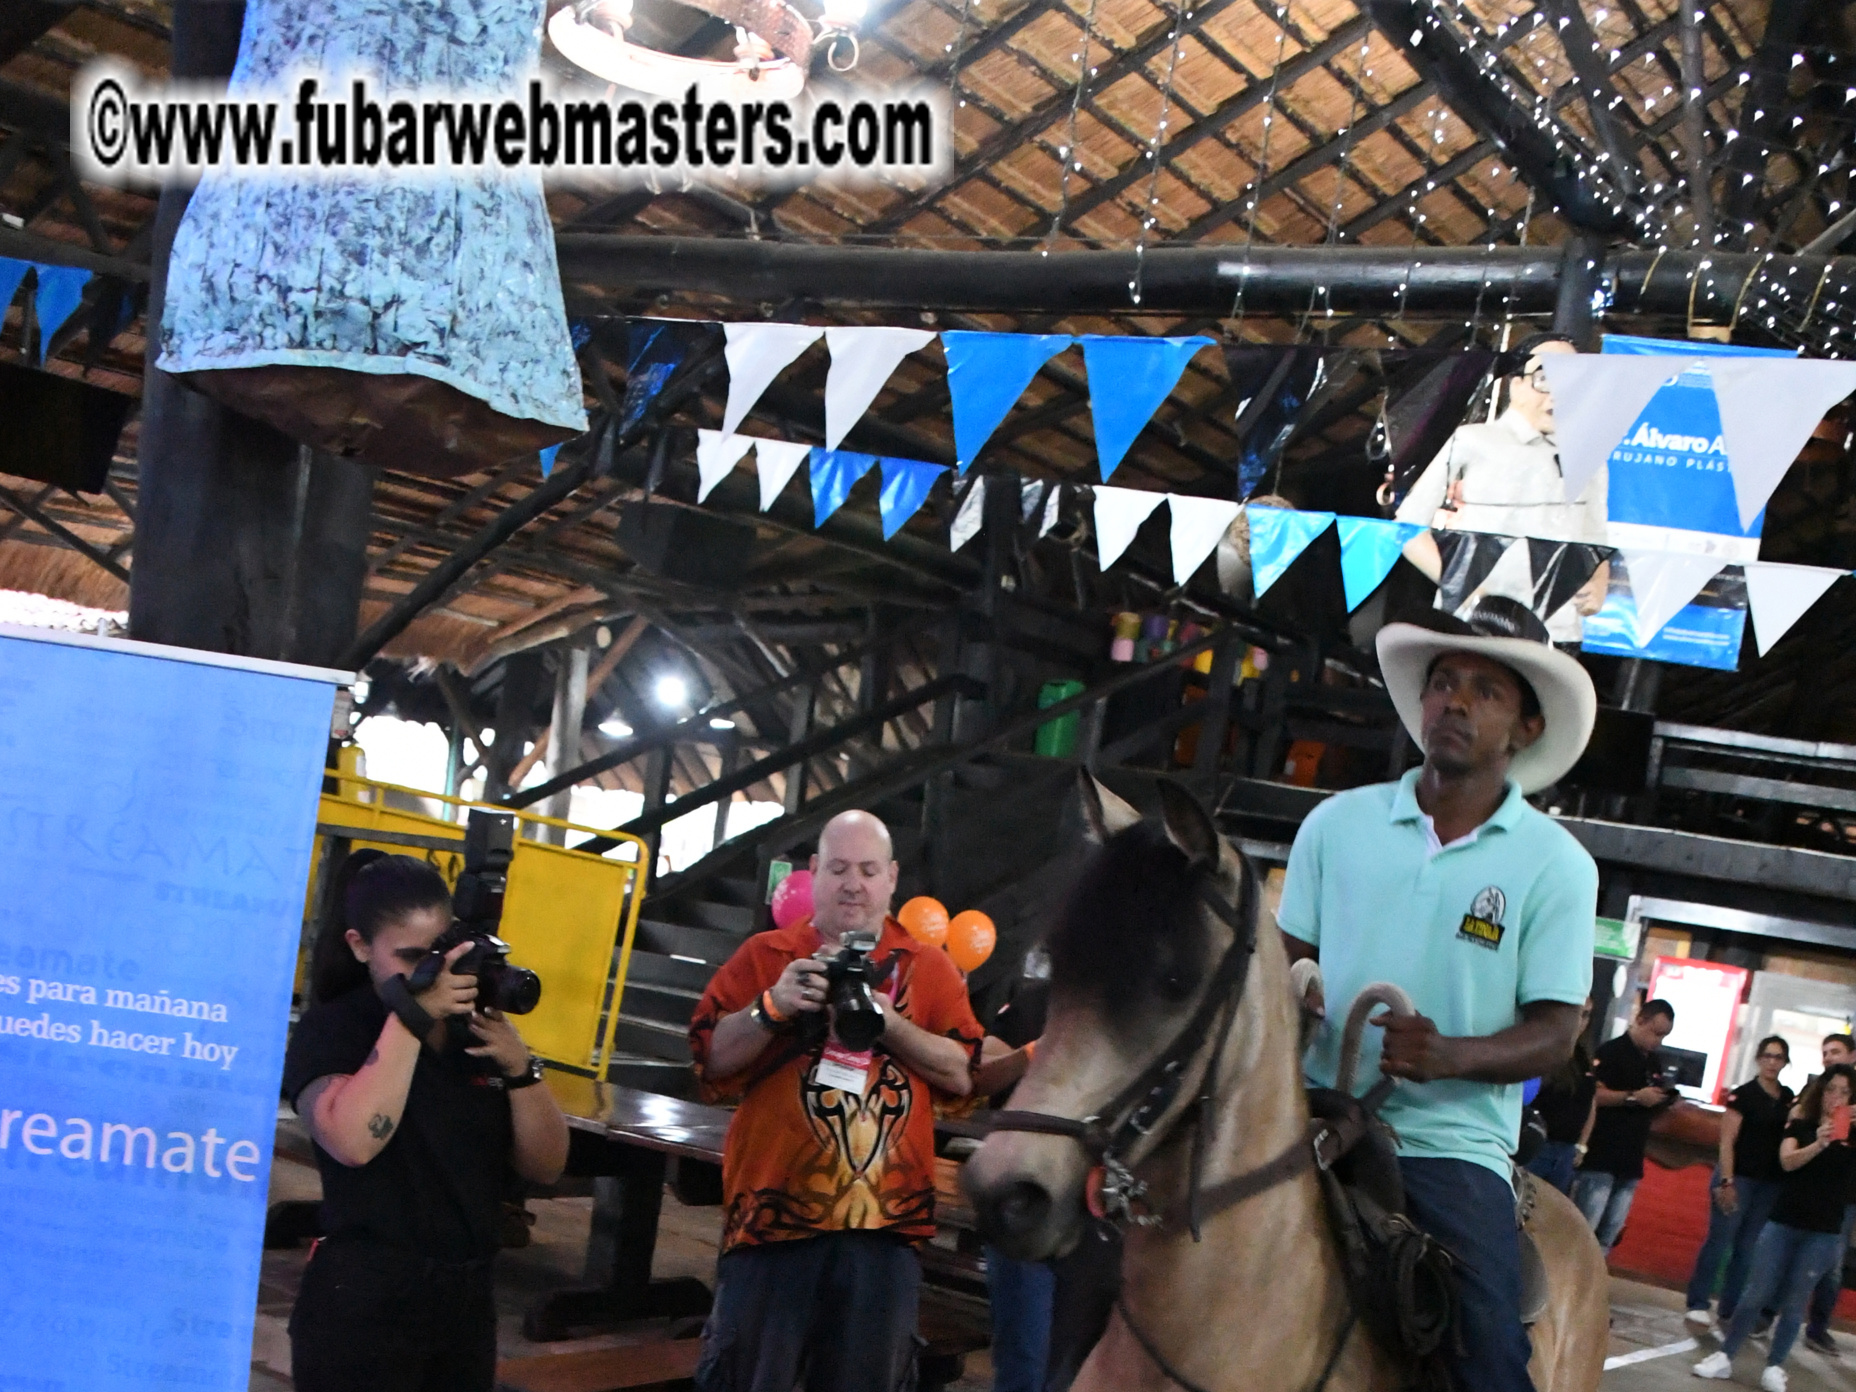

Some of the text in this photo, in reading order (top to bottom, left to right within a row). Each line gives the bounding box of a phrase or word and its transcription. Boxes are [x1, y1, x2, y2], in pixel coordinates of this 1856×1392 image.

[25, 978, 97, 1005] para
[104, 988, 228, 1023] mañana
[88, 1019, 176, 1056] hacer
[182, 1032, 239, 1071] hoy
[0, 1108, 261, 1182] reamate
